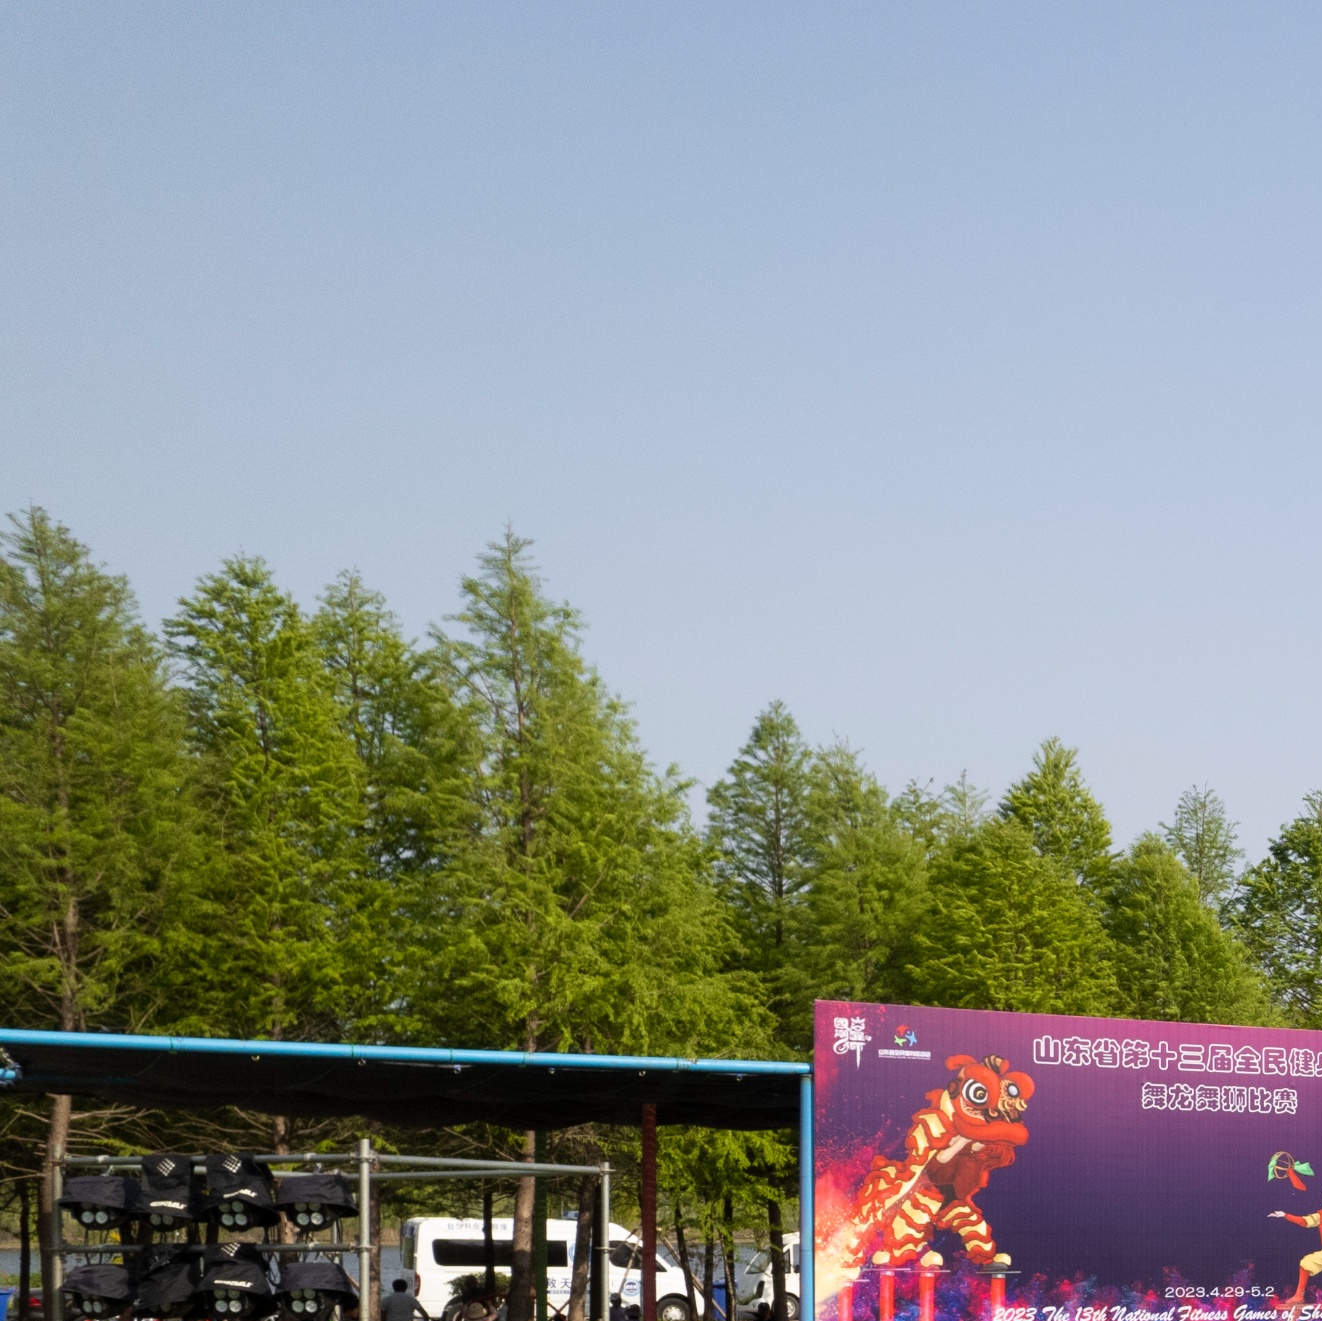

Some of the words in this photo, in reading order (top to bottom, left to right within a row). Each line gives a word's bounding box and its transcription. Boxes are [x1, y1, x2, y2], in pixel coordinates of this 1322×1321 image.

[1141, 1082, 1298, 1115] 舞龙舞狮比赛
[1164, 1286, 1275, 1298] 2023.4.29-5.2
